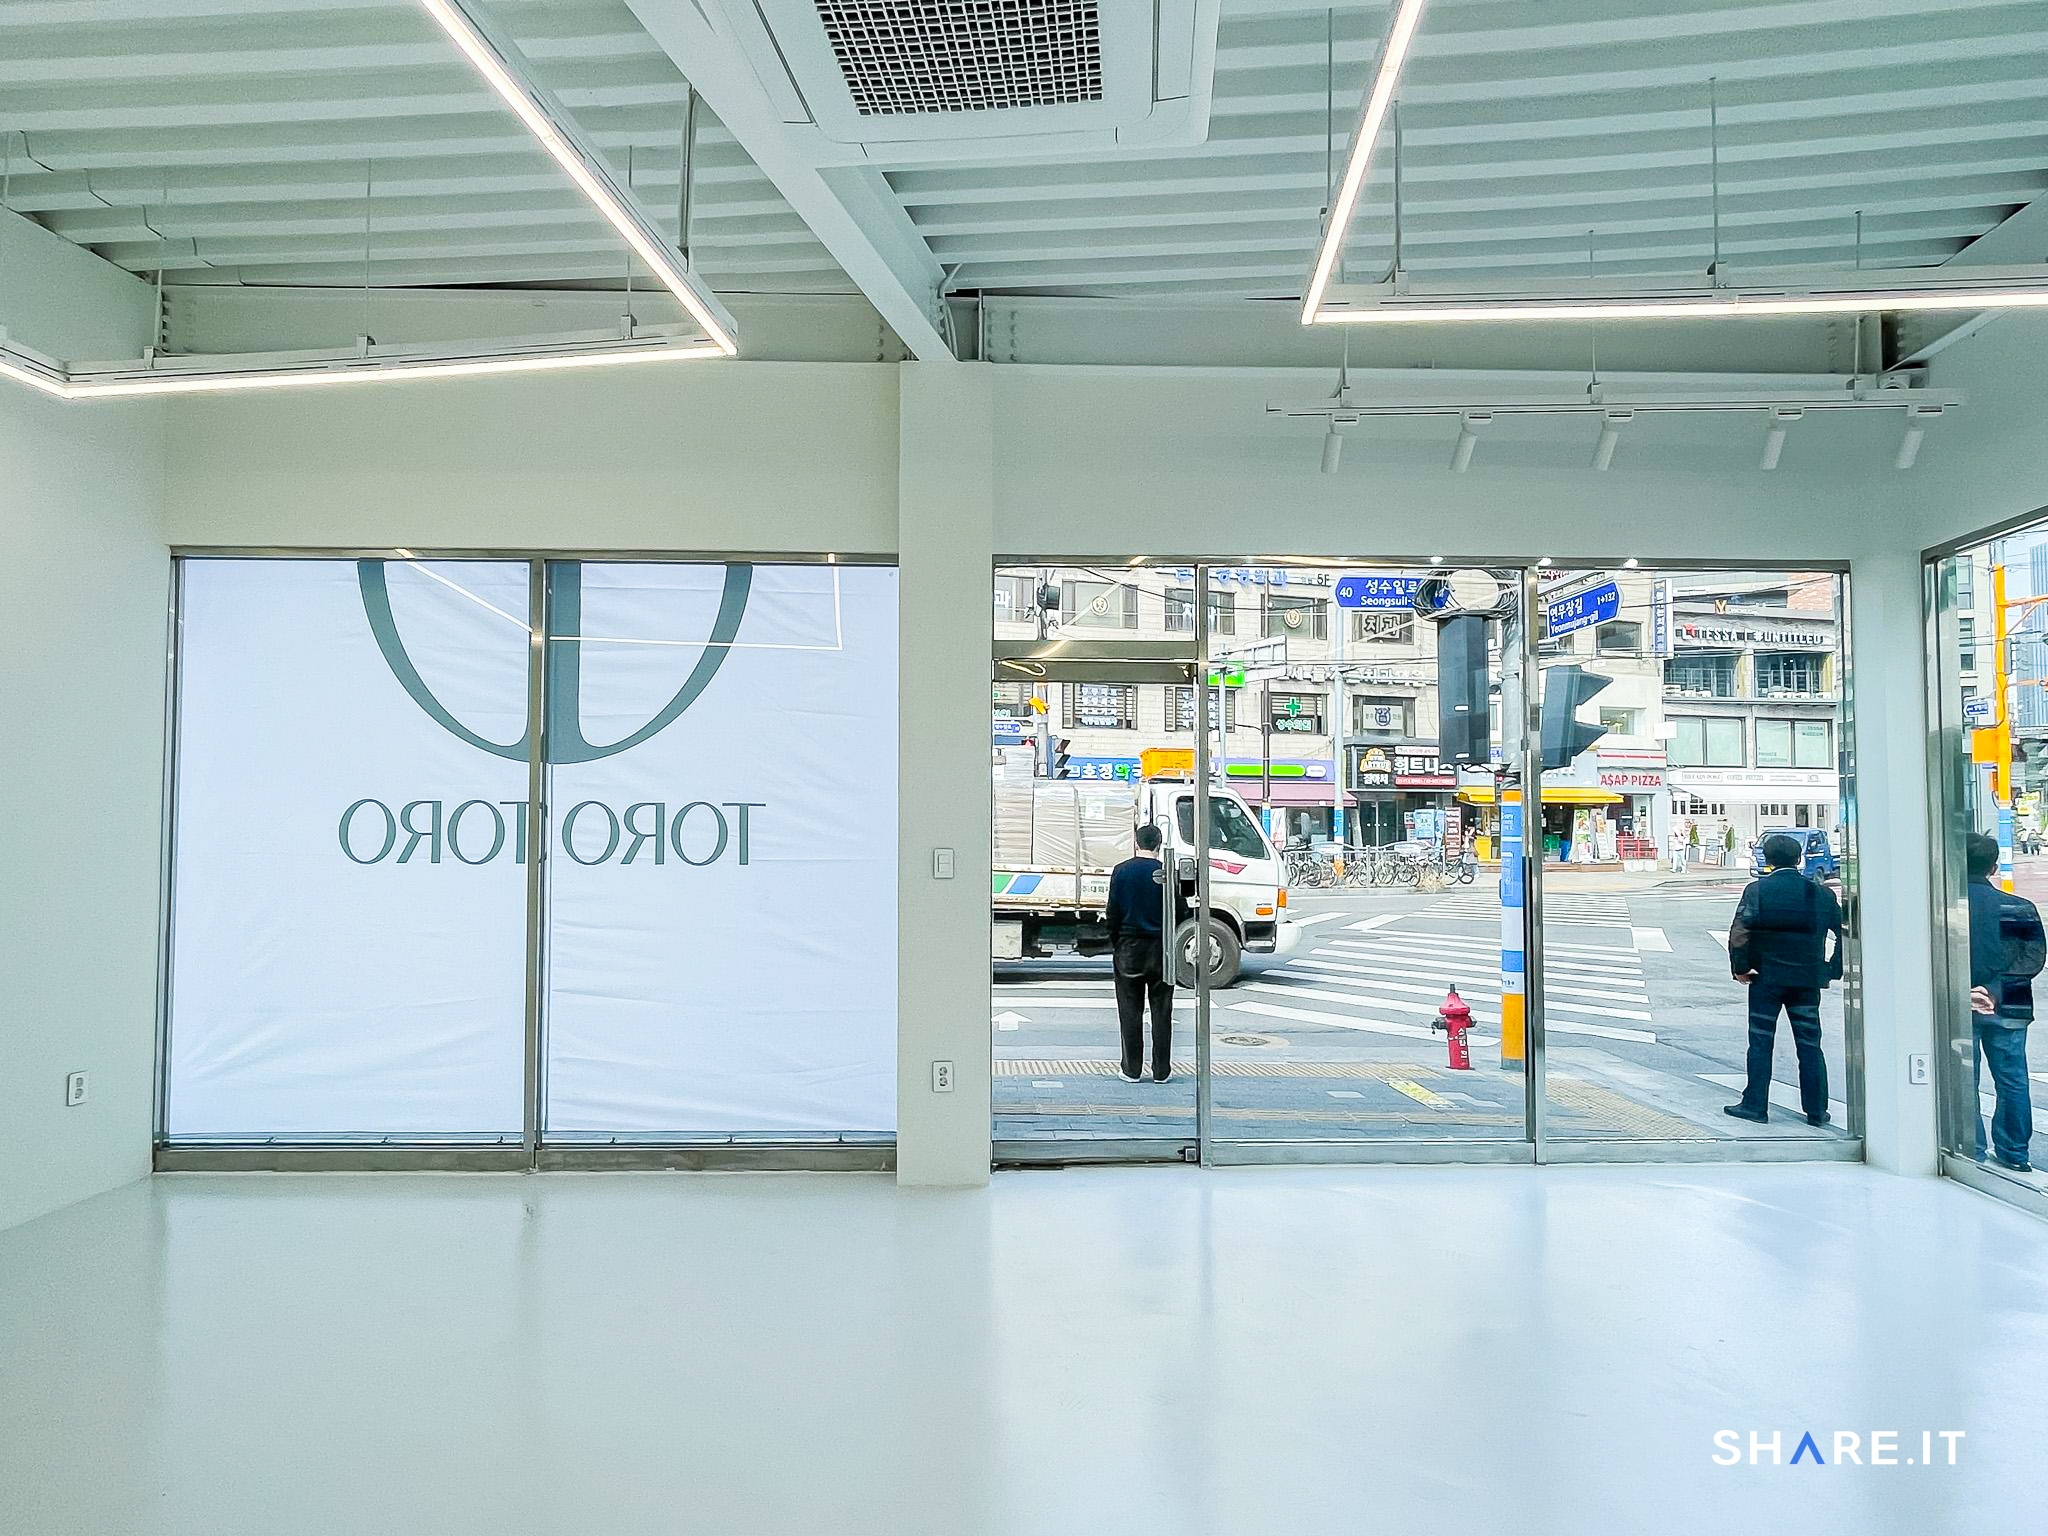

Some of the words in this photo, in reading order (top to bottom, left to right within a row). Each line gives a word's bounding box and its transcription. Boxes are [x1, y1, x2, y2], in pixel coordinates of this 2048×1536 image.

[1339, 587, 1353, 598] 40
[1360, 595, 1415, 608] Seongsuil-
[1549, 596, 1583, 623] 연무장길
[1364, 614, 1400, 637] 치과
[1698, 626, 1738, 642] TESSA
[1631, 775, 1662, 787] PIZZA
